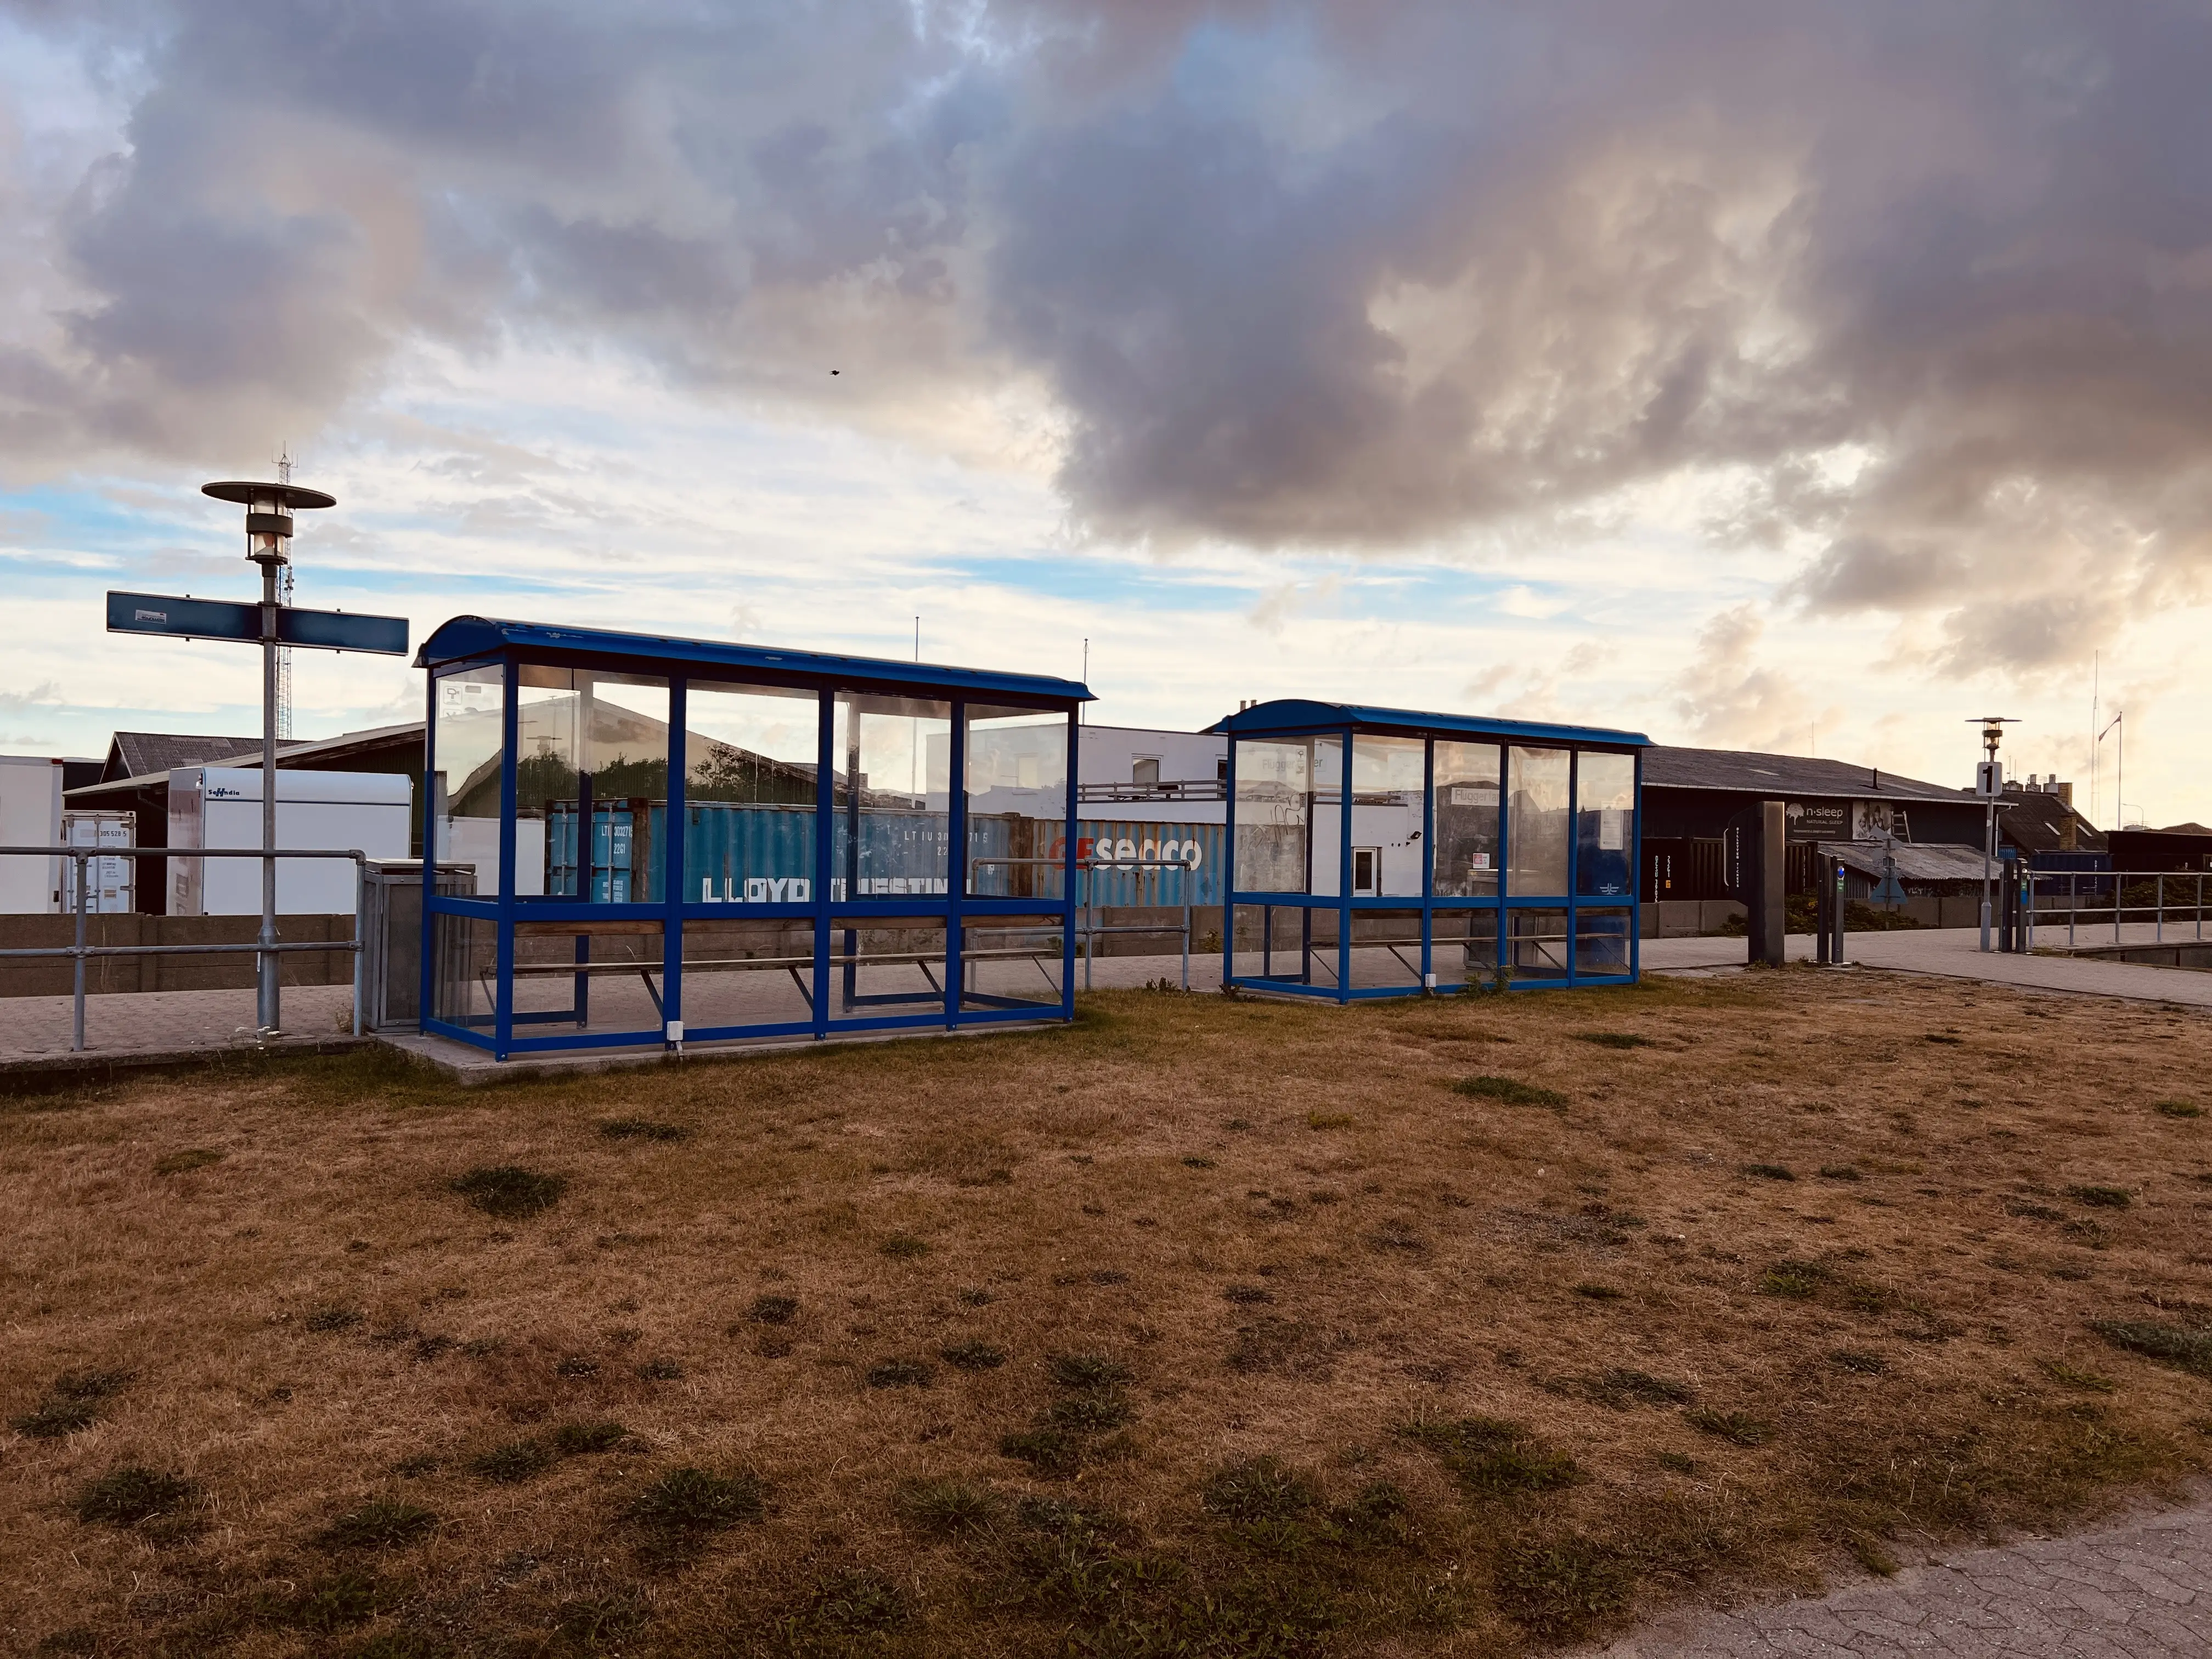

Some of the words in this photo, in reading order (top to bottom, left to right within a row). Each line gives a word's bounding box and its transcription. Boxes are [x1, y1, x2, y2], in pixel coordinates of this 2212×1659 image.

[1982, 765, 1993, 793] 1
[613, 843, 626, 854] 22G1
[702, 878, 810, 902] LLOYD
